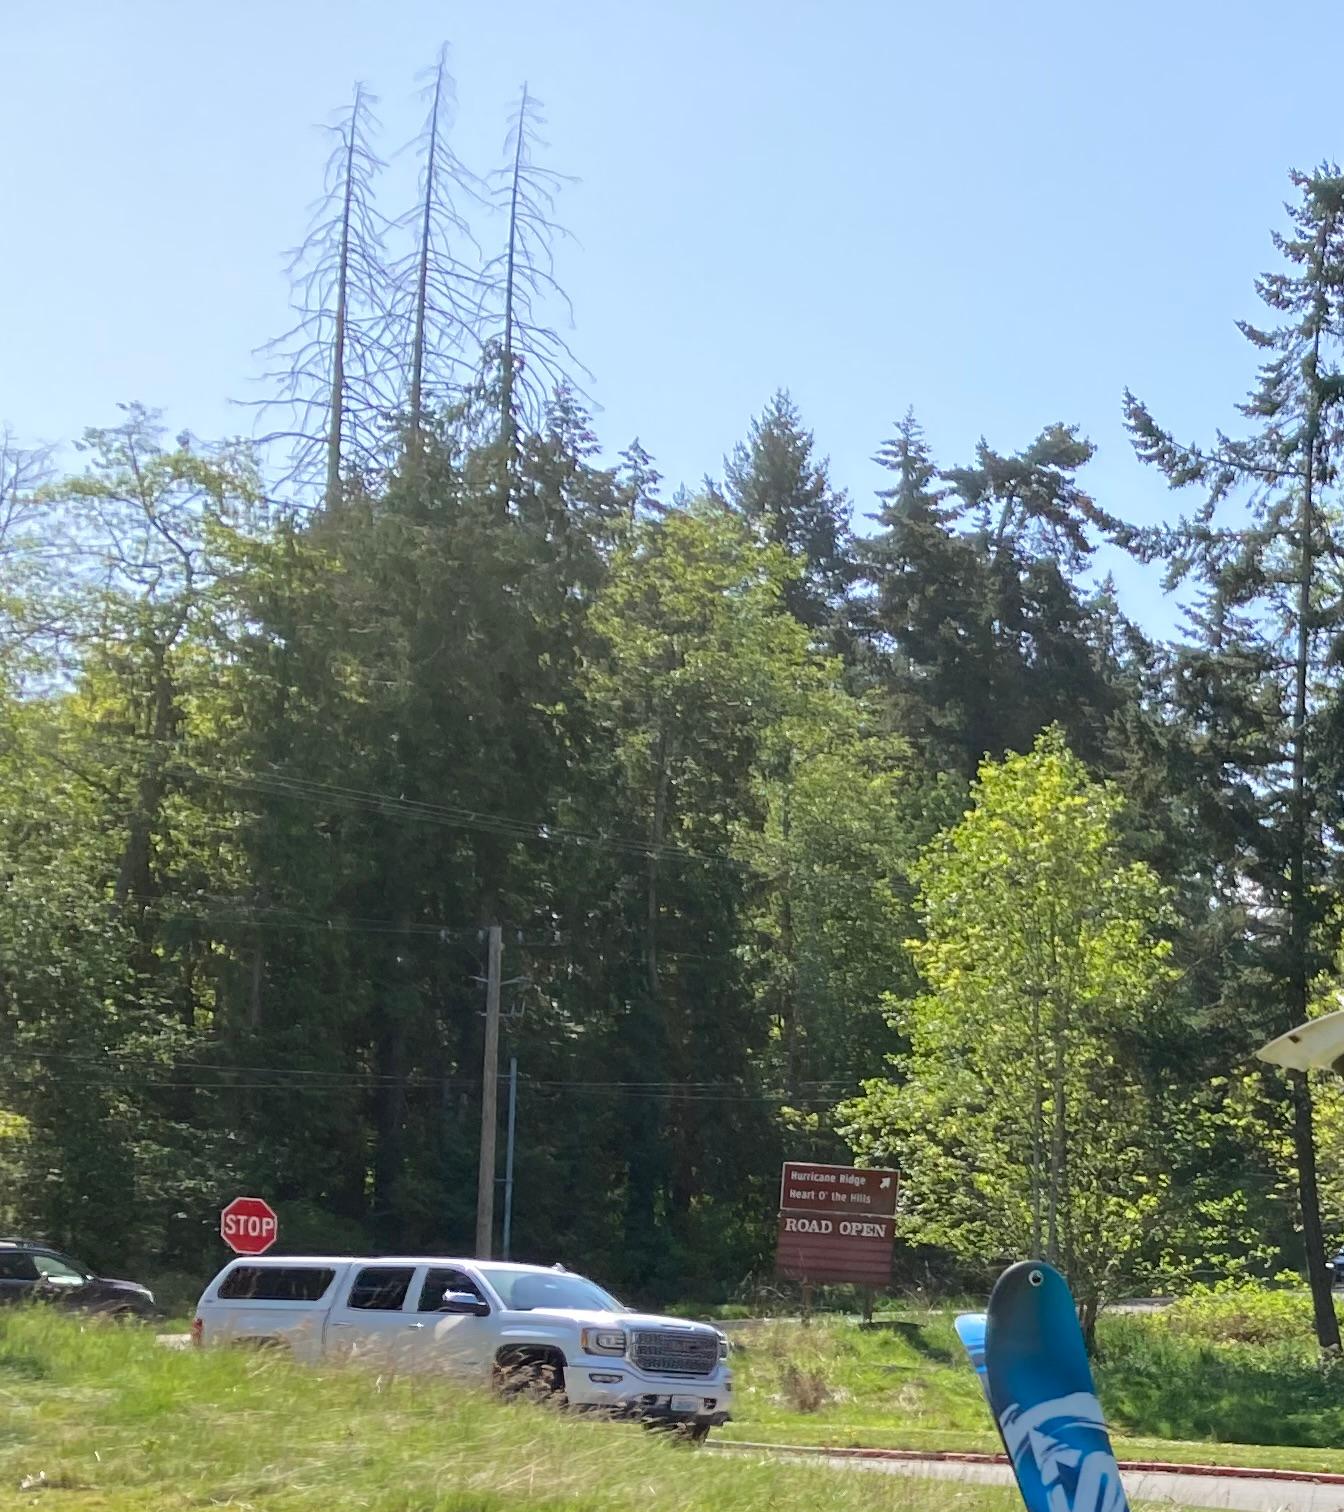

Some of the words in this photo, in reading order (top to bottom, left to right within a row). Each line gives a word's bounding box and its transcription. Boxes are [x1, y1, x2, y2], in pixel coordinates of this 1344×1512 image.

[791, 1171, 836, 1183] Hurricane
[839, 1174, 866, 1186] Ridge
[789, 1189, 815, 1200] Heart
[831, 1191, 847, 1203] the
[850, 1193, 871, 1204] Hills
[225, 1214, 274, 1237] STOP
[785, 1218, 833, 1234] ROAD
[839, 1221, 887, 1238] OPEN
